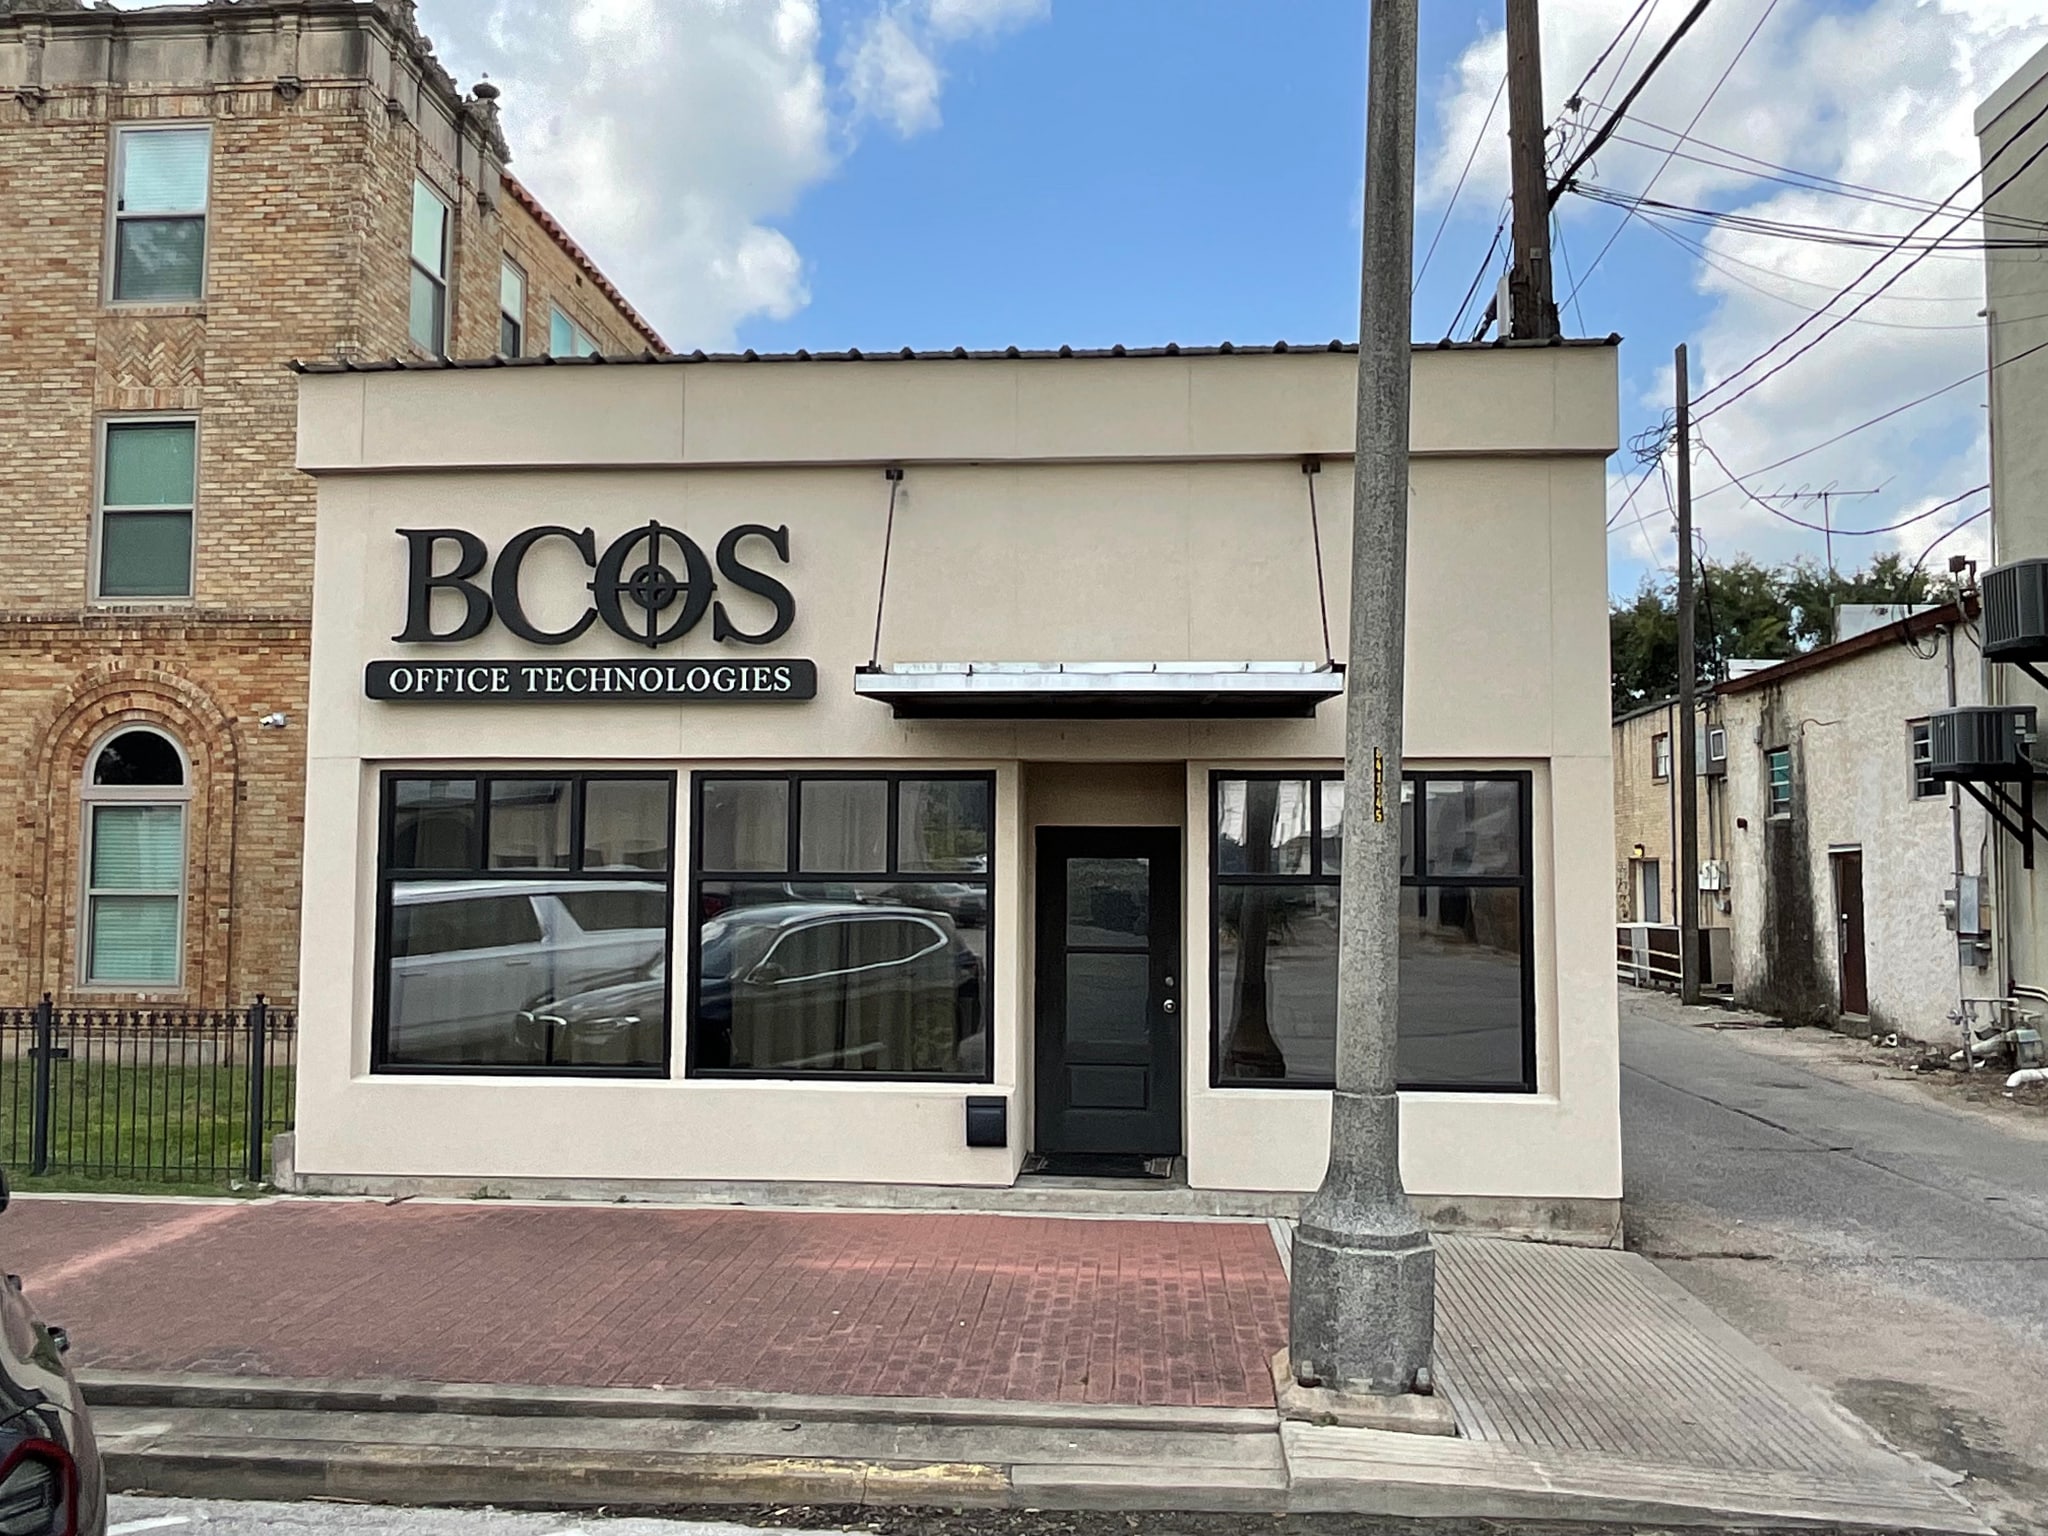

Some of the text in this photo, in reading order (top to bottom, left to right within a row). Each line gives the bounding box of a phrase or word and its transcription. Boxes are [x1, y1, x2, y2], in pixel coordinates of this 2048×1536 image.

[391, 519, 796, 649] BCOS
[389, 666, 792, 693] OFFICE TECHNOLOGIES
